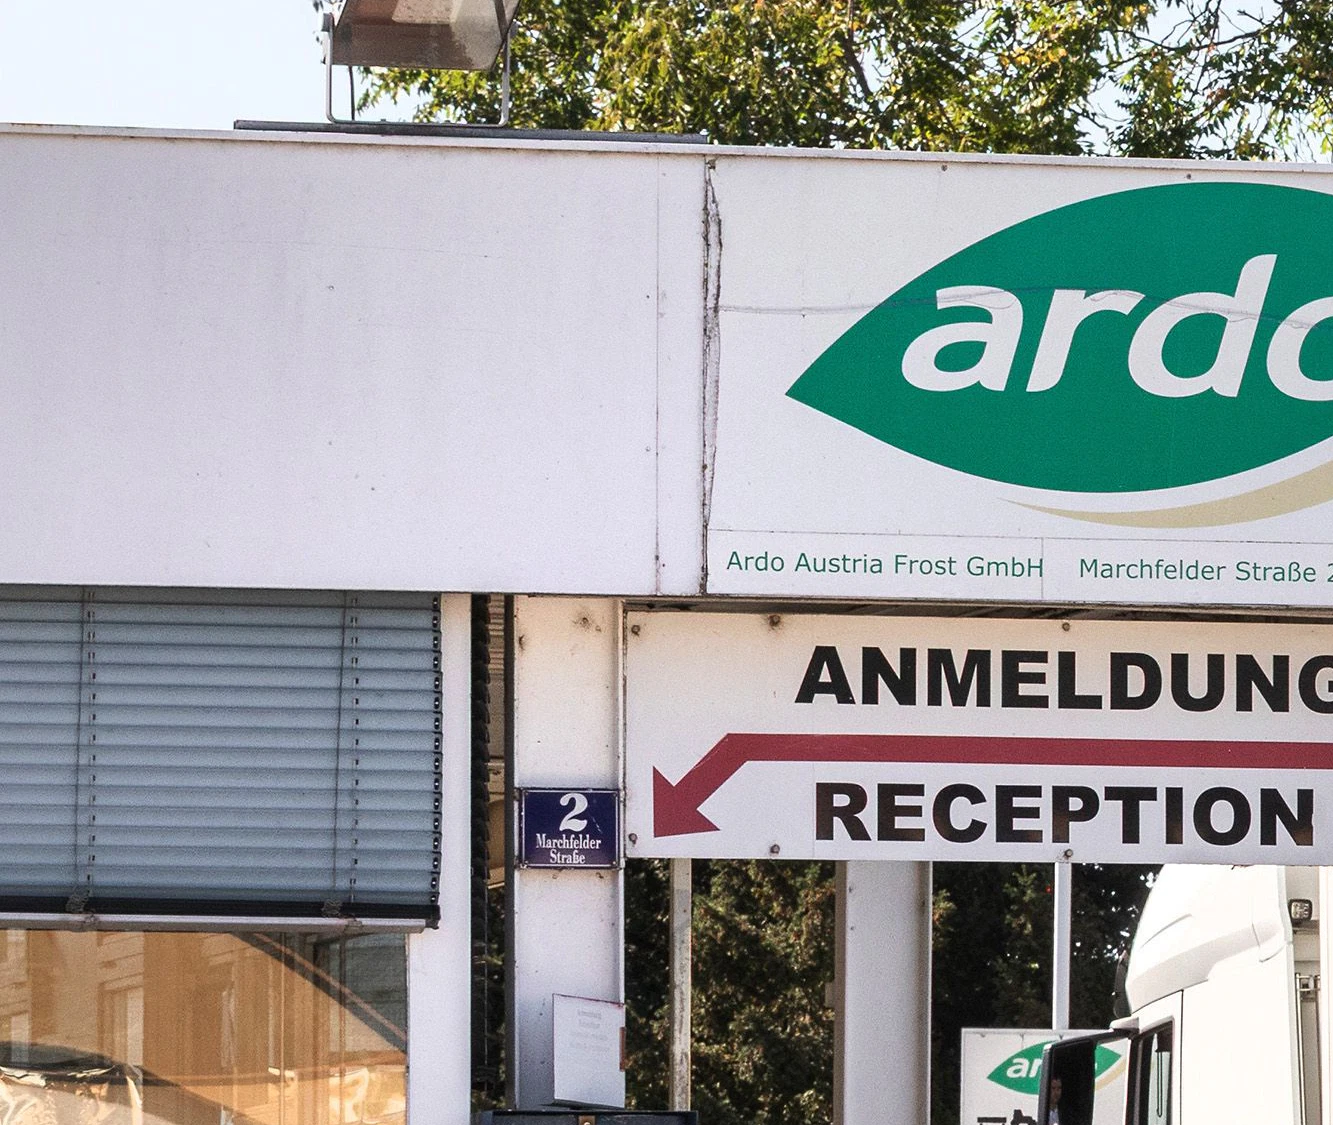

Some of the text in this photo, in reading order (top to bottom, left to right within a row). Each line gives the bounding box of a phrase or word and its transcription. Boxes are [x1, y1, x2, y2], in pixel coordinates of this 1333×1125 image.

[726, 551, 1043, 578] Ardo Austria Frost GmbH
[1079, 558, 1226, 583] Marchfelder
[1235, 560, 1316, 584] Straße
[559, 793, 588, 832] 2
[815, 784, 1315, 847] RECEPTION
[536, 834, 601, 849] Marchfelder
[550, 849, 585, 864] Straße
